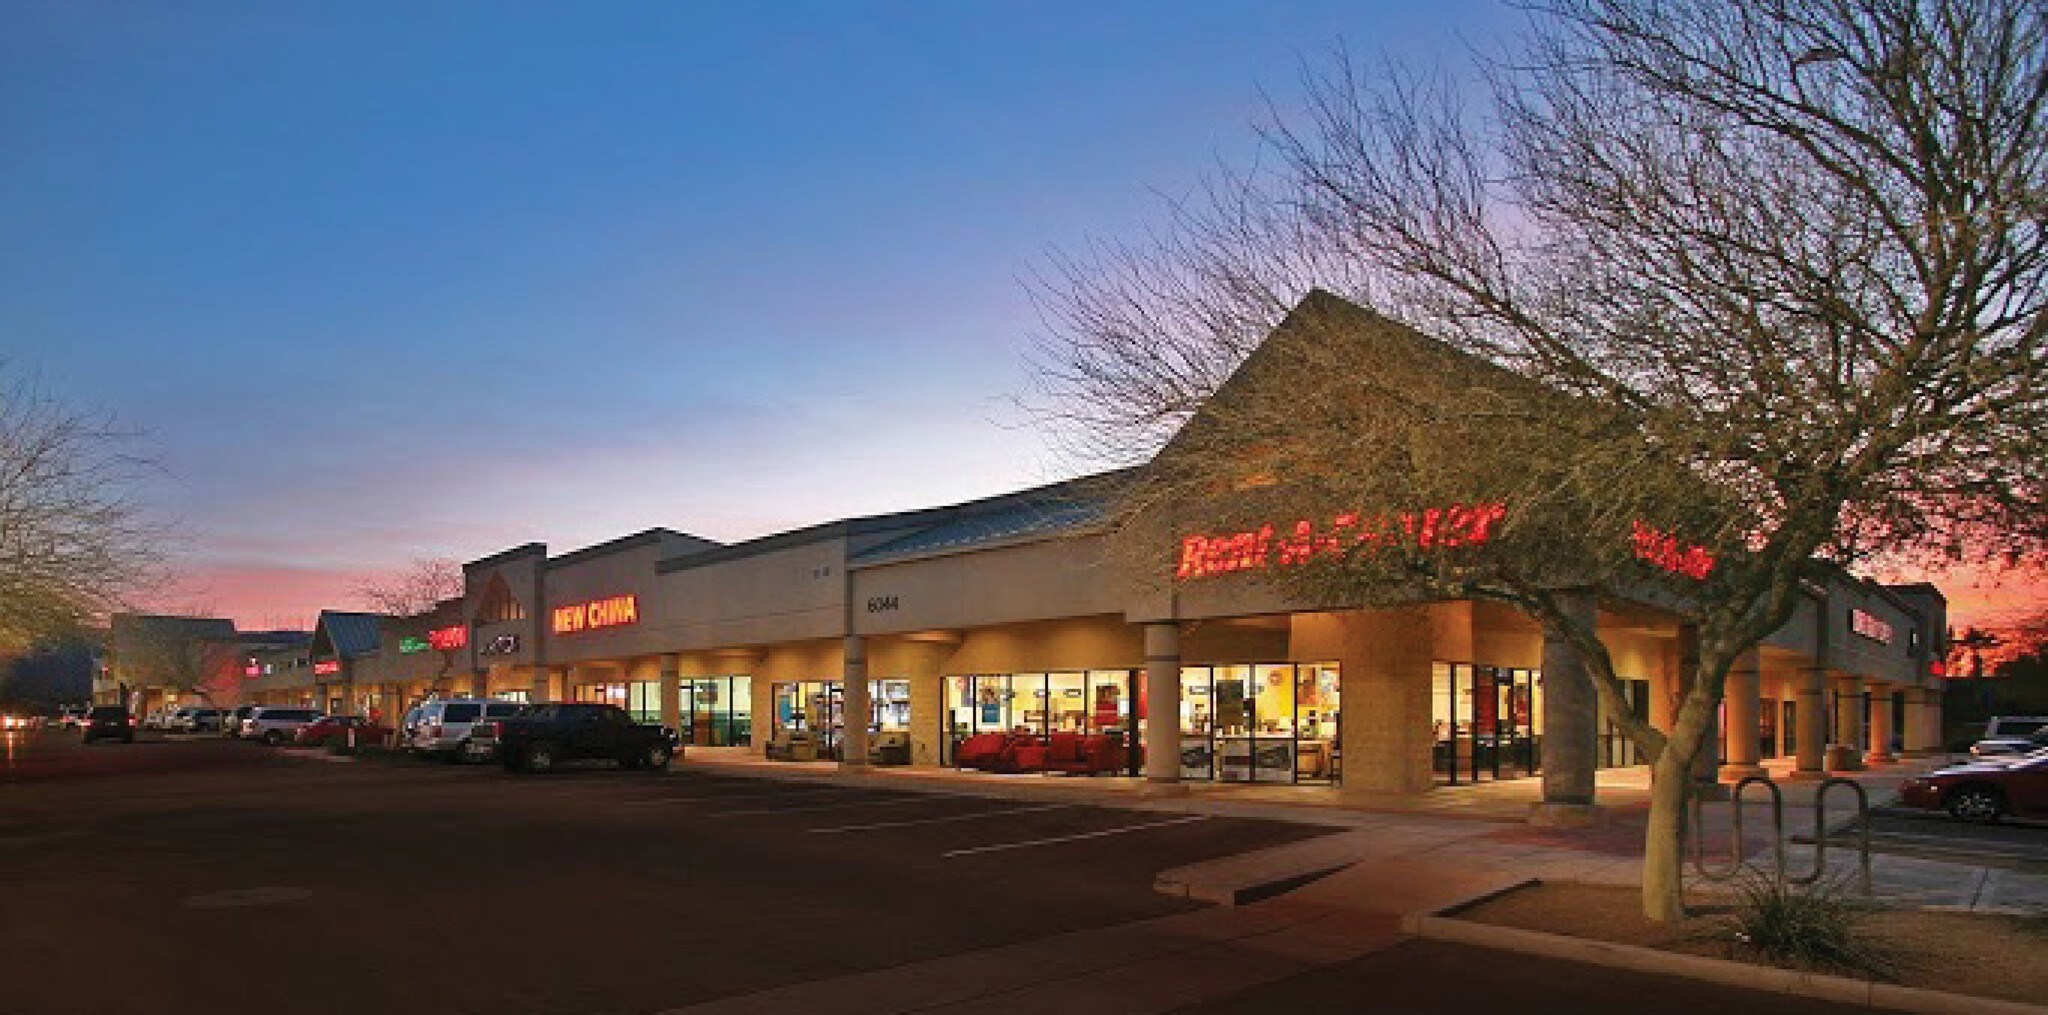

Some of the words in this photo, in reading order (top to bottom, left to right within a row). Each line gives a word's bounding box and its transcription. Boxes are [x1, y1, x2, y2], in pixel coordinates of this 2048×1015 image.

[553, 604, 587, 634] NEW
[588, 595, 637, 629] CHINA
[867, 595, 899, 614] 6044
